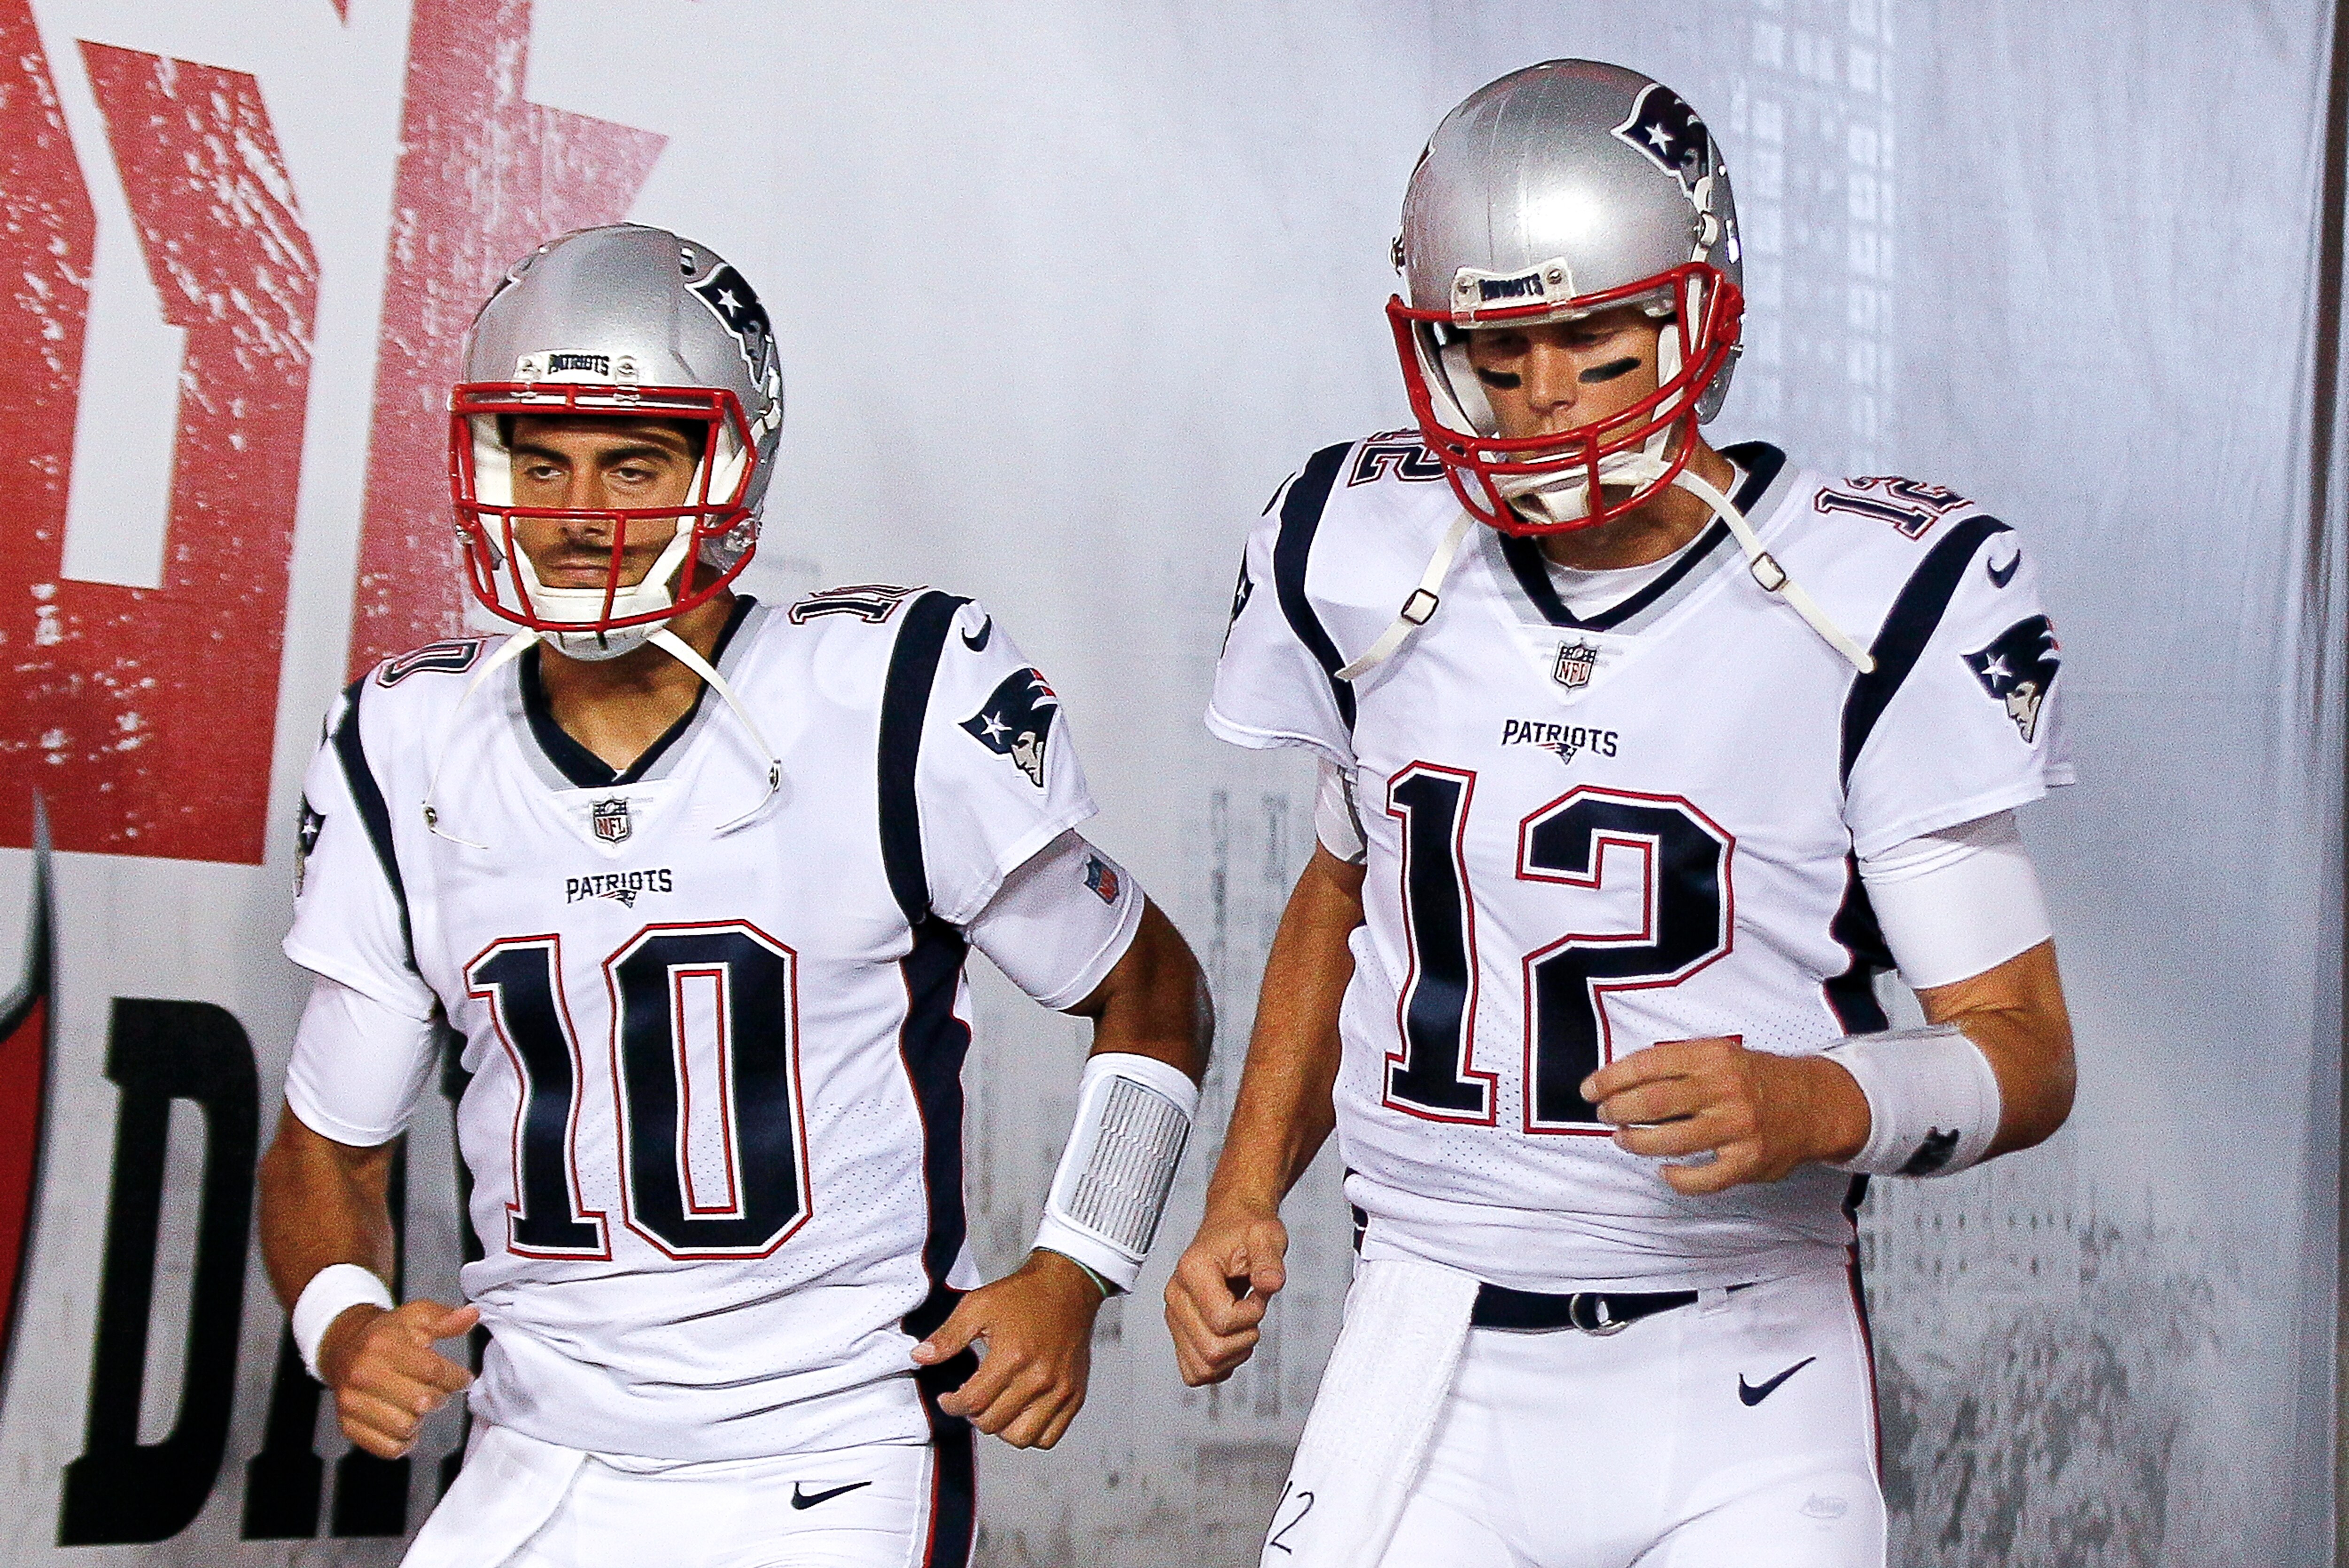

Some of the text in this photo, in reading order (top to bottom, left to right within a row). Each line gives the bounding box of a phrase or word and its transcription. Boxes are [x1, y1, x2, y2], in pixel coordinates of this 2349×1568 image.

[1558, 660, 1592, 684] NFL
[1501, 719, 1618, 758] PATRIOTS
[596, 816, 626, 838] NFL
[565, 869, 672, 904] PATRIOTS
[1382, 759, 1744, 1135] 12
[462, 918, 813, 1261] 10
